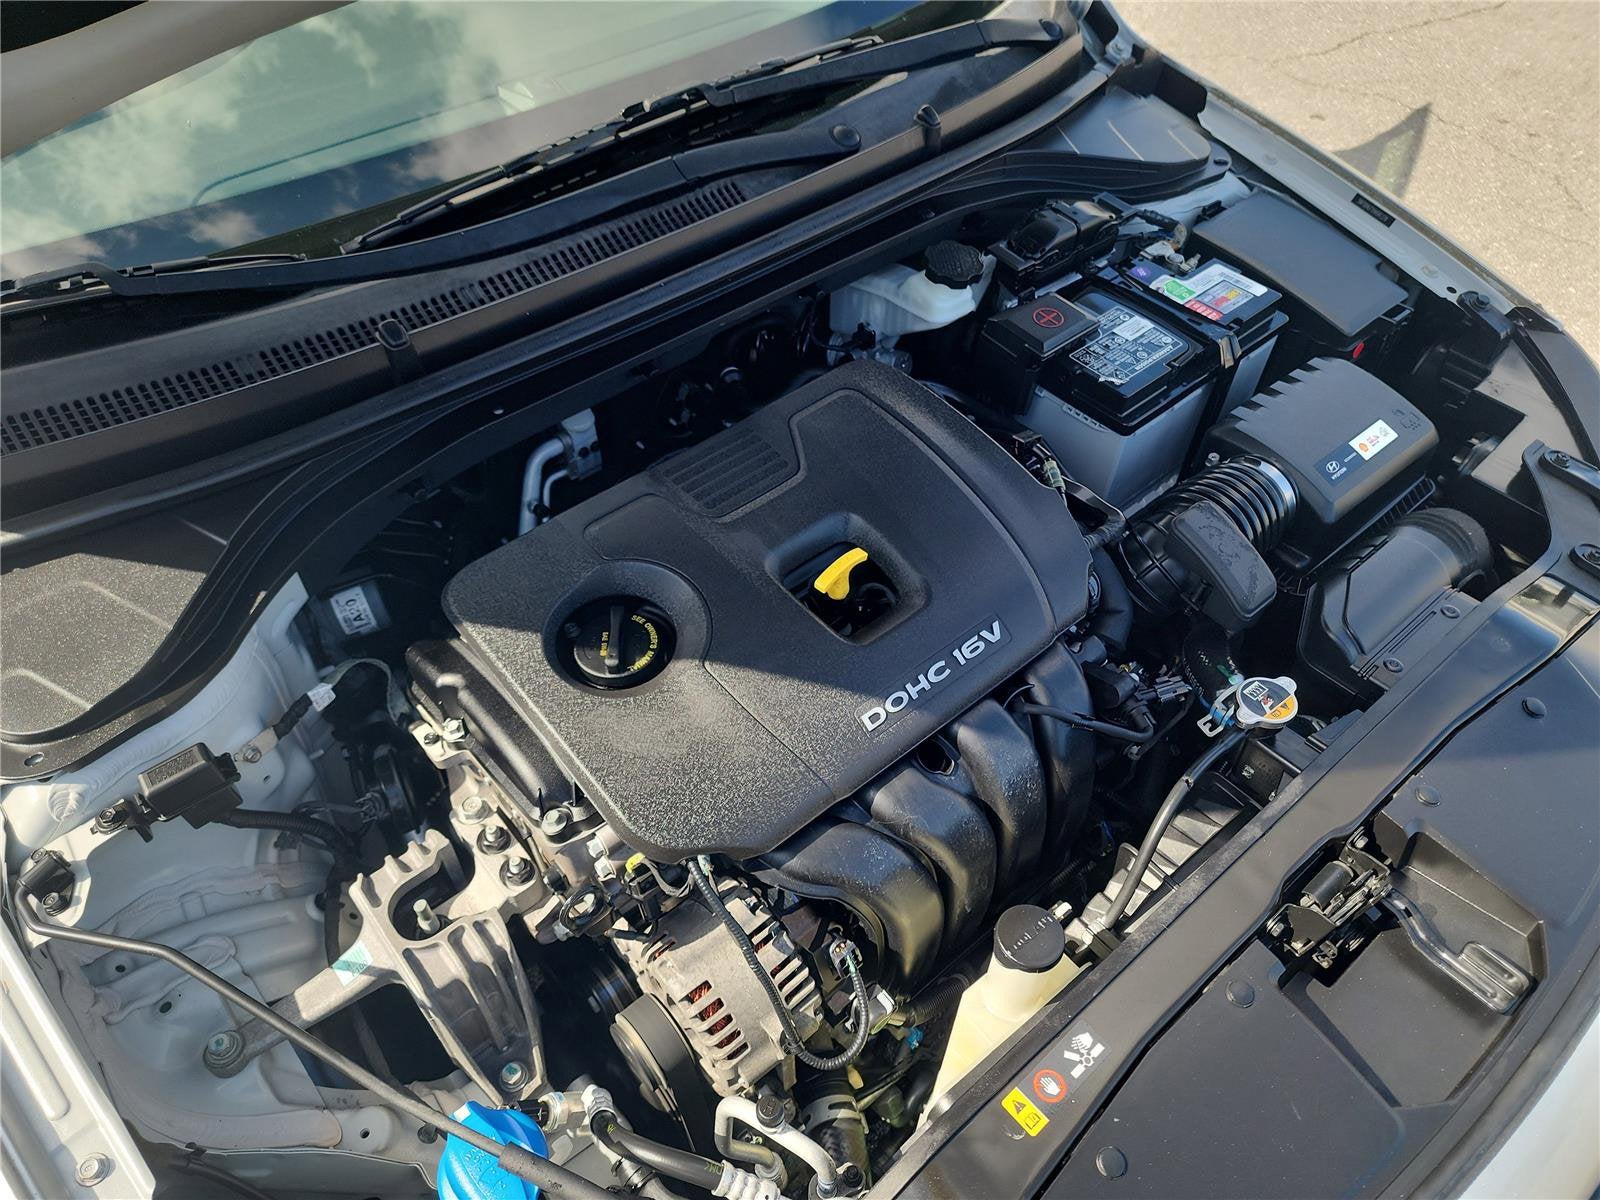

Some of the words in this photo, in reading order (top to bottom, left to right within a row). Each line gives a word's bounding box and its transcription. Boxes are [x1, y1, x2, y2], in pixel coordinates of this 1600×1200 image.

[631, 614, 647, 626] SEE
[626, 650, 656, 673] MANUAL
[861, 660, 952, 732] DOHC
[952, 620, 1002, 666] 16V
